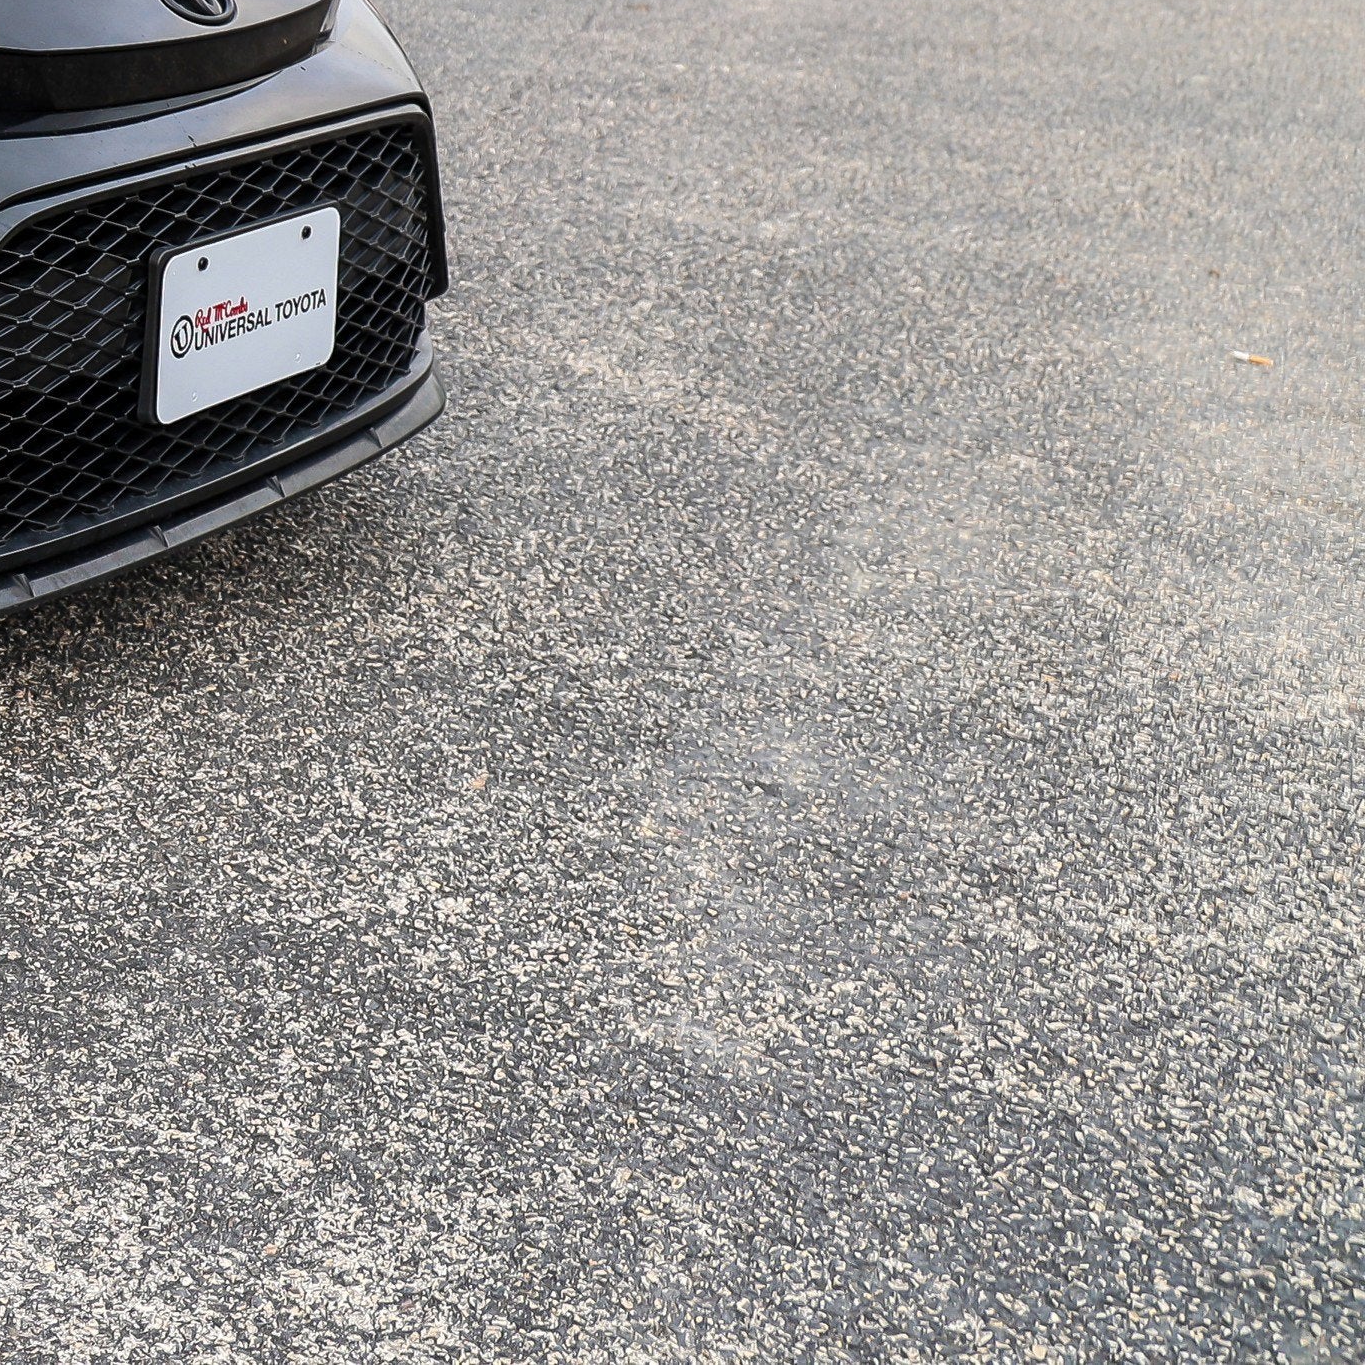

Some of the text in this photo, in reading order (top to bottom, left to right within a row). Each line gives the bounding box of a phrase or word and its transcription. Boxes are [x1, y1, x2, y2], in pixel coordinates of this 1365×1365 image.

[194, 308, 273, 351] UNIVERSAL
[275, 288, 327, 322] TOYOTA
[195, 306, 212, 332] Red
